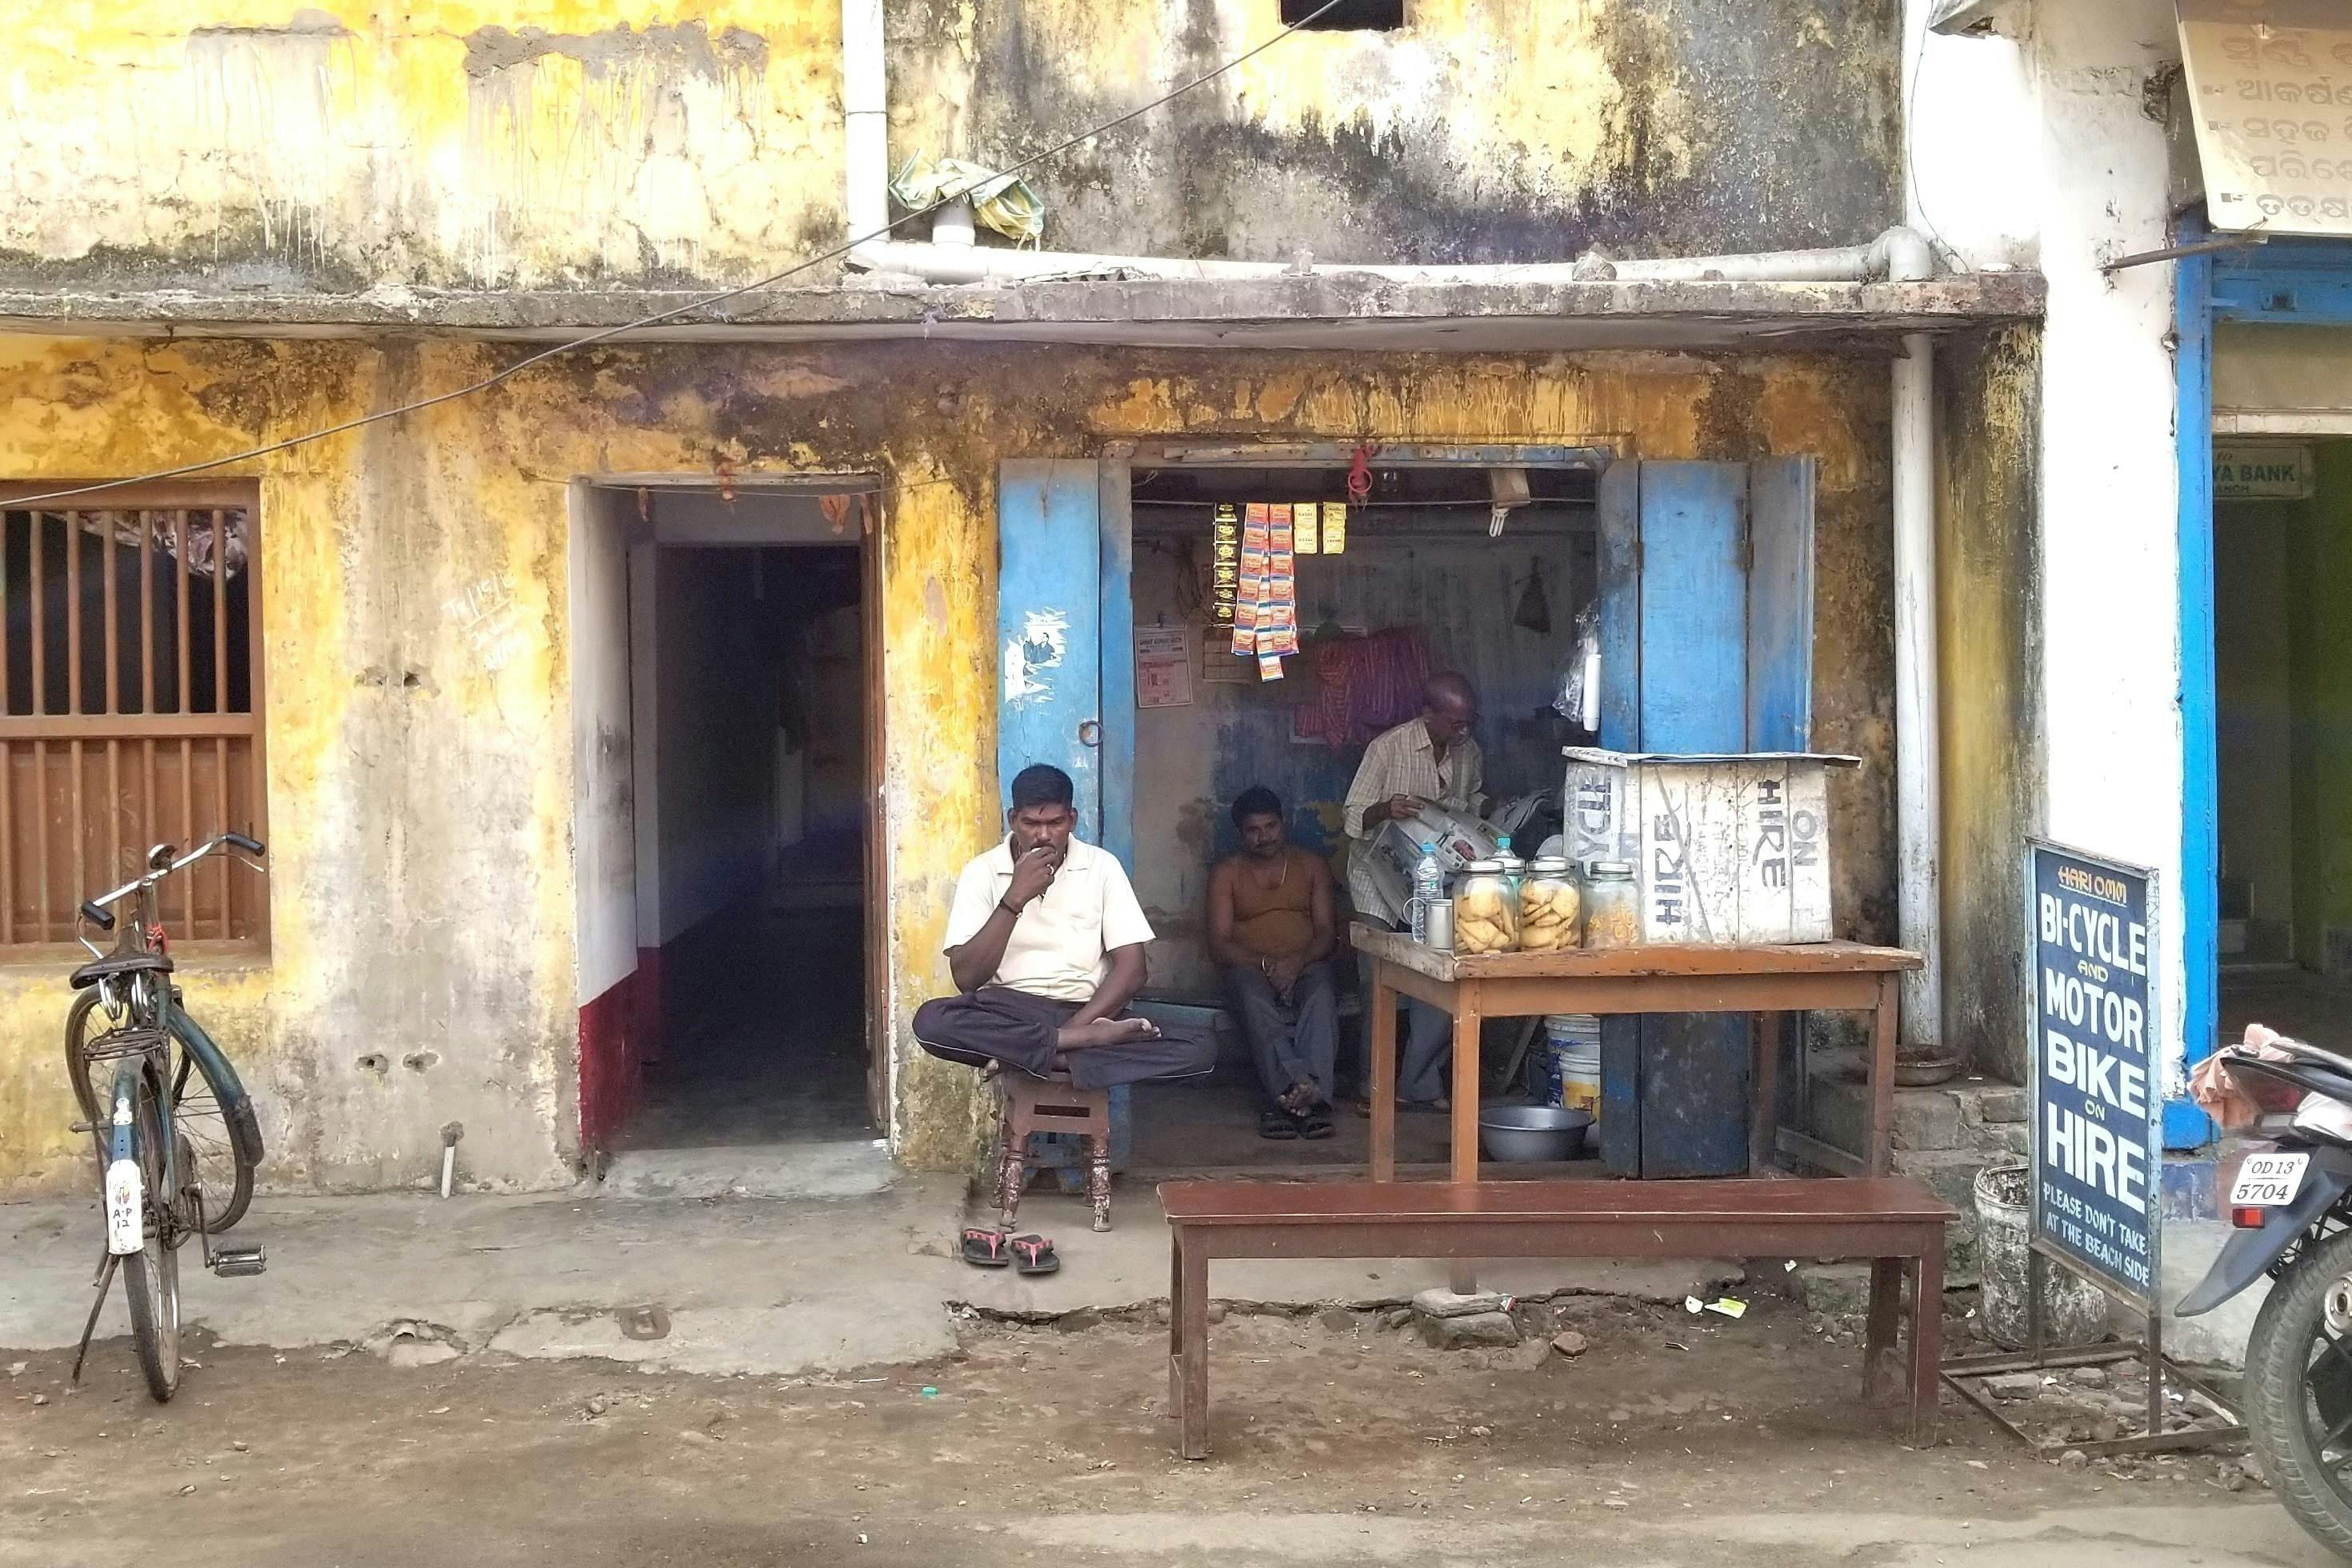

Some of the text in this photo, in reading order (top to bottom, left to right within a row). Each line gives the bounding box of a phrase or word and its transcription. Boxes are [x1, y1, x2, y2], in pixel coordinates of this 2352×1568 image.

[2240, 464, 2295, 482] BANK
[1752, 778, 1786, 889] HIRE
[1791, 809, 1818, 866] ON
[2058, 866, 2092, 893] HARI
[2041, 892, 2146, 977] BI-CYCLE
[2077, 960, 2109, 983] AND
[2046, 967, 2144, 1054] MOTOR
[2047, 1029, 2146, 1119] BIKE
[2085, 1099, 2106, 1121] ON
[2047, 1101, 2146, 1214] HIRE
[2251, 1161, 2294, 1174] OD 13
[2043, 1182, 2148, 1255] PLEASE DON'T TAKE
[2237, 1184, 2289, 1200] 5704
[2046, 1211, 2150, 1287] AT THE BEACH SIDE
